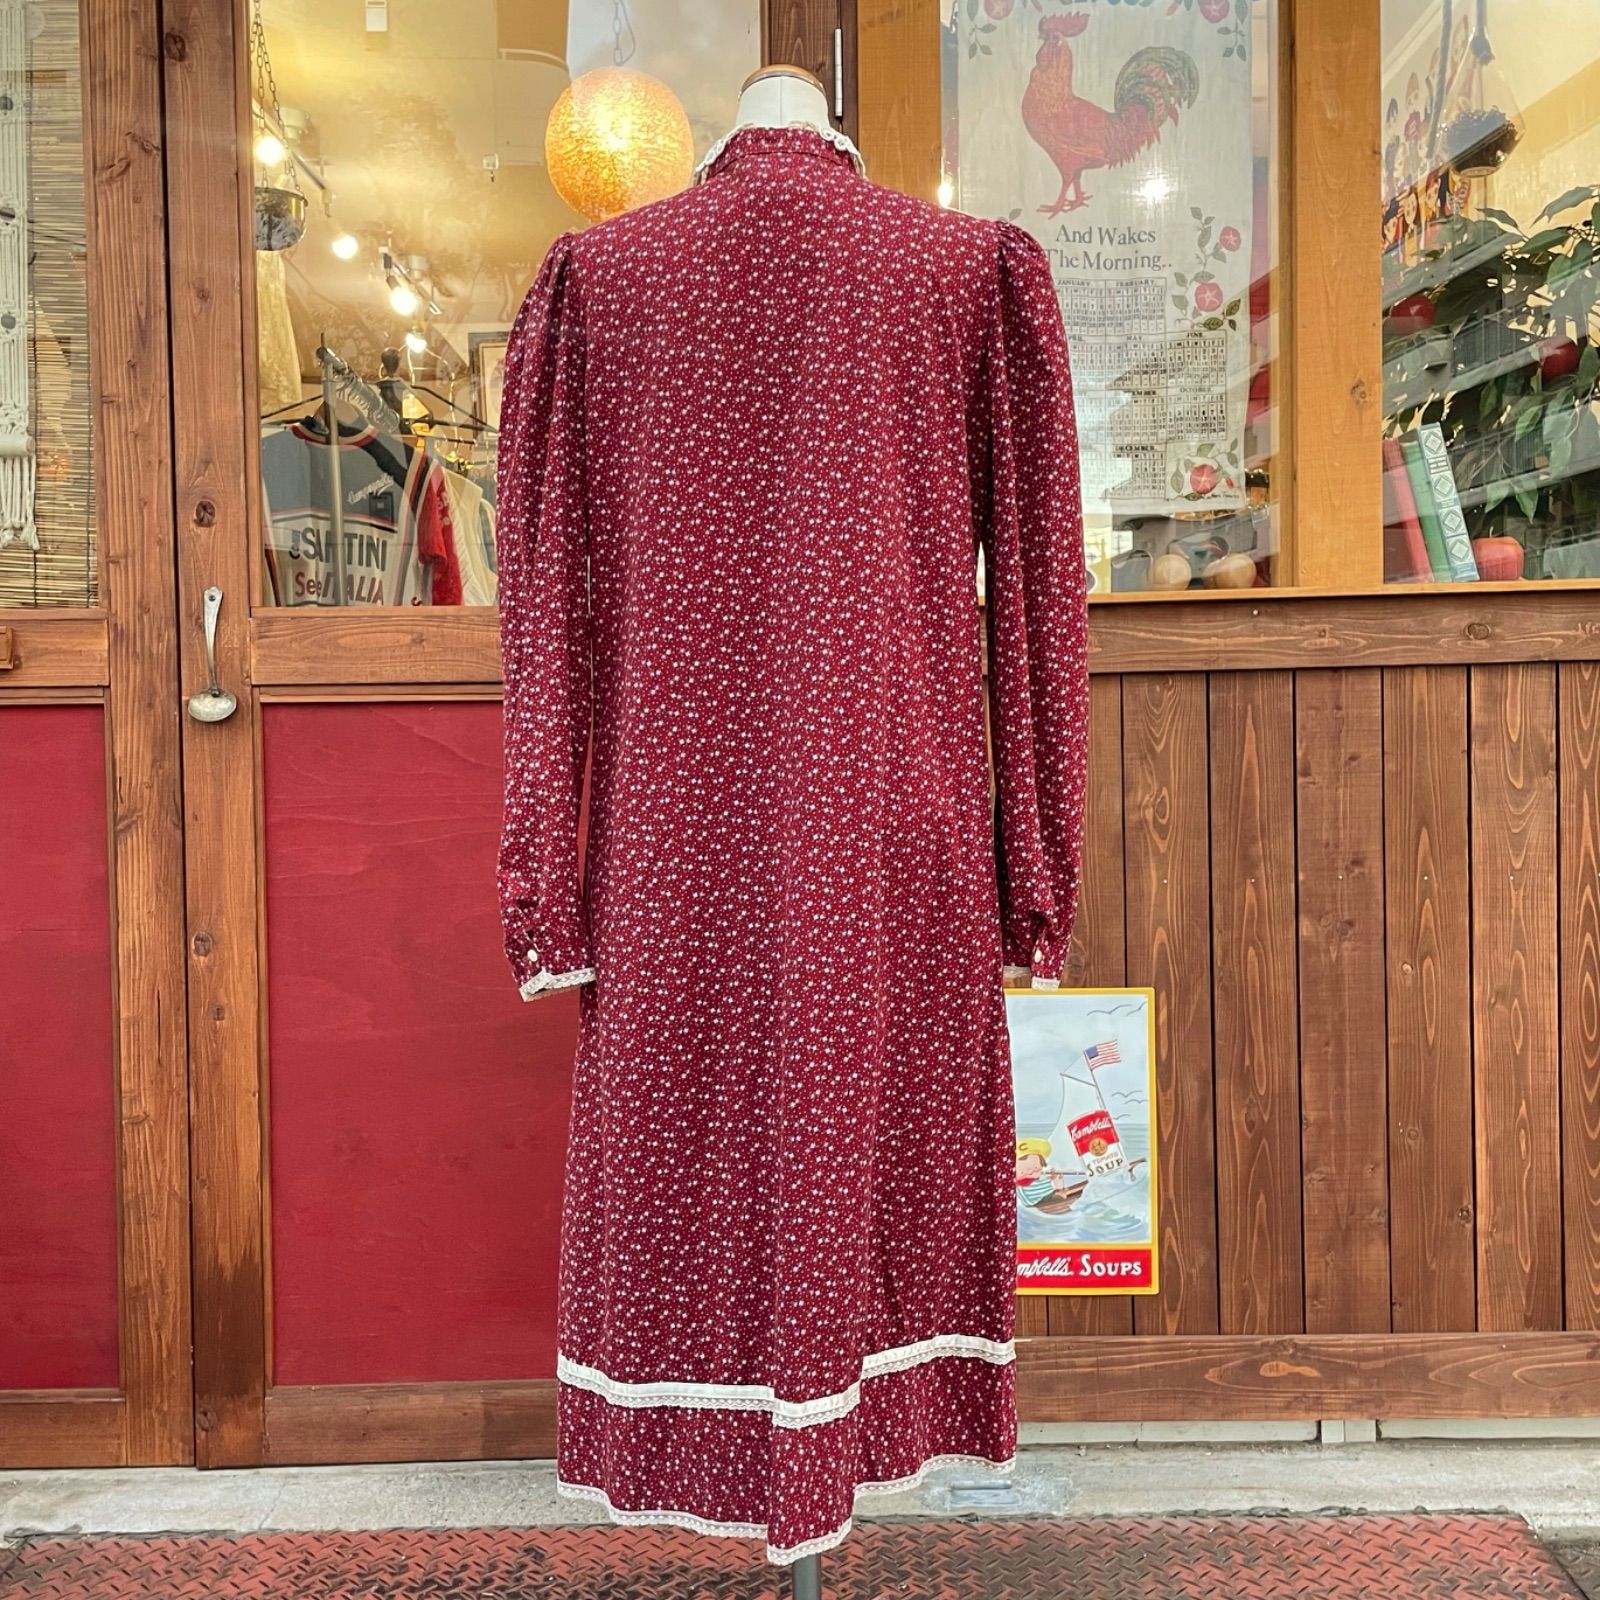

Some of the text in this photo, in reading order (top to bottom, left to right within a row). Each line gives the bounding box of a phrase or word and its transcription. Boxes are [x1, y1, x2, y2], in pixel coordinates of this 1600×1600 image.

[1056, 224, 1156, 246] And Wakes
[1046, 249, 1079, 268] The
[1087, 1158, 1123, 1177] SOUP
[1017, 1254, 1142, 1278] mpbell's SOUPS
